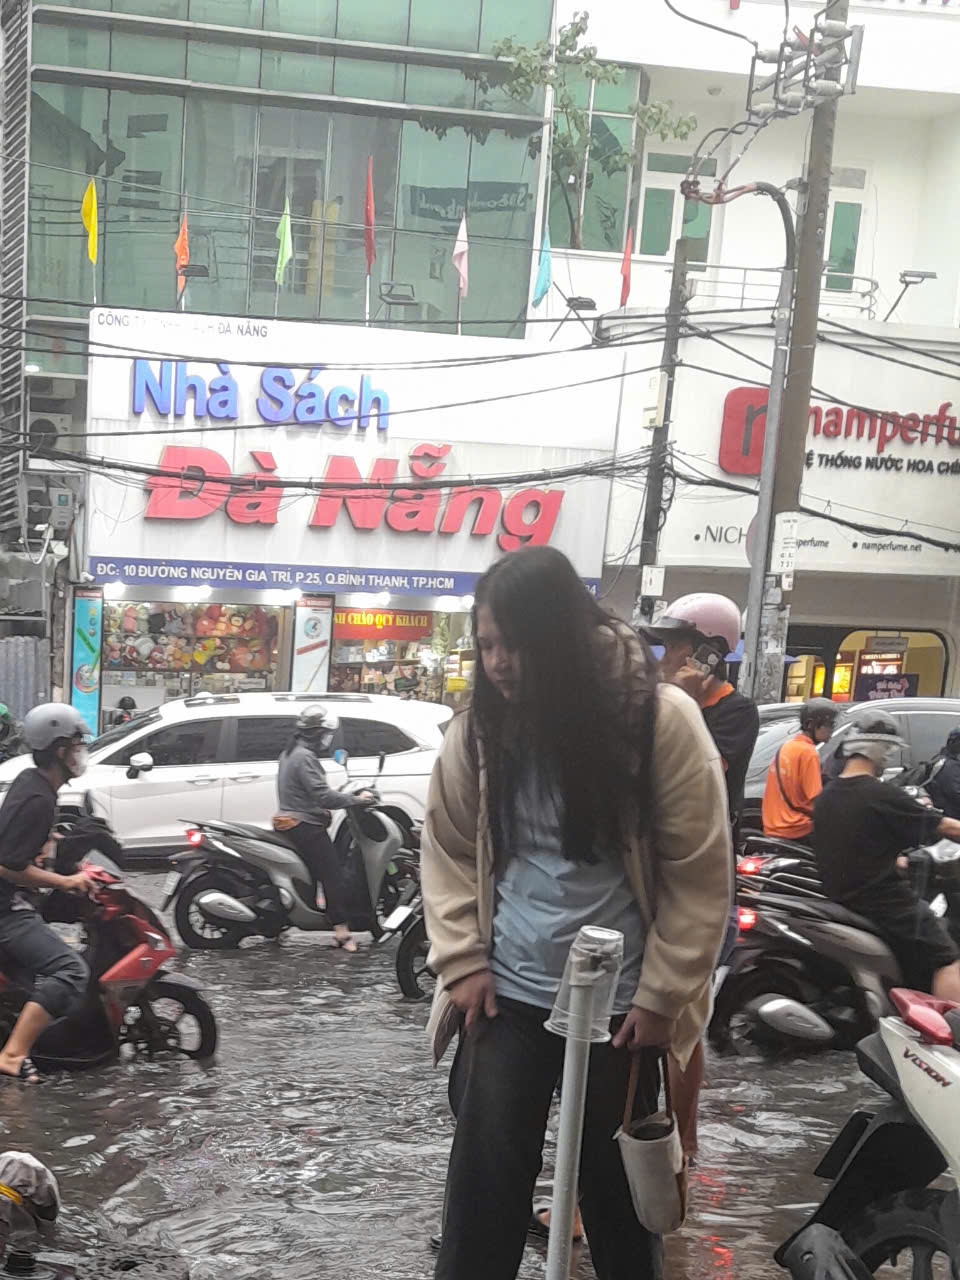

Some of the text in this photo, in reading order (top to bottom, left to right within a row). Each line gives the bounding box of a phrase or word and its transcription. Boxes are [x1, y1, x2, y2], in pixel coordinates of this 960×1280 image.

[97, 311, 130, 327] CÔNG
[132, 357, 390, 430] Nhà Sách
[818, 450, 862, 470] THỐNG
[865, 454, 903, 472] NƯỚC
[907, 457, 934, 473] HOA
[144, 442, 565, 552] Đà Nẵng
[861, 541, 922, 553] namperfume.net
[96, 563, 120, 576] ĐC:
[123, 564, 137, 577] 10
[138, 561, 188, 579] ĐƯỜNG
[245, 569, 268, 582] GIA
[412, 577, 455, 589] TP.HCM
[903, 1046, 954, 1088] VISION
